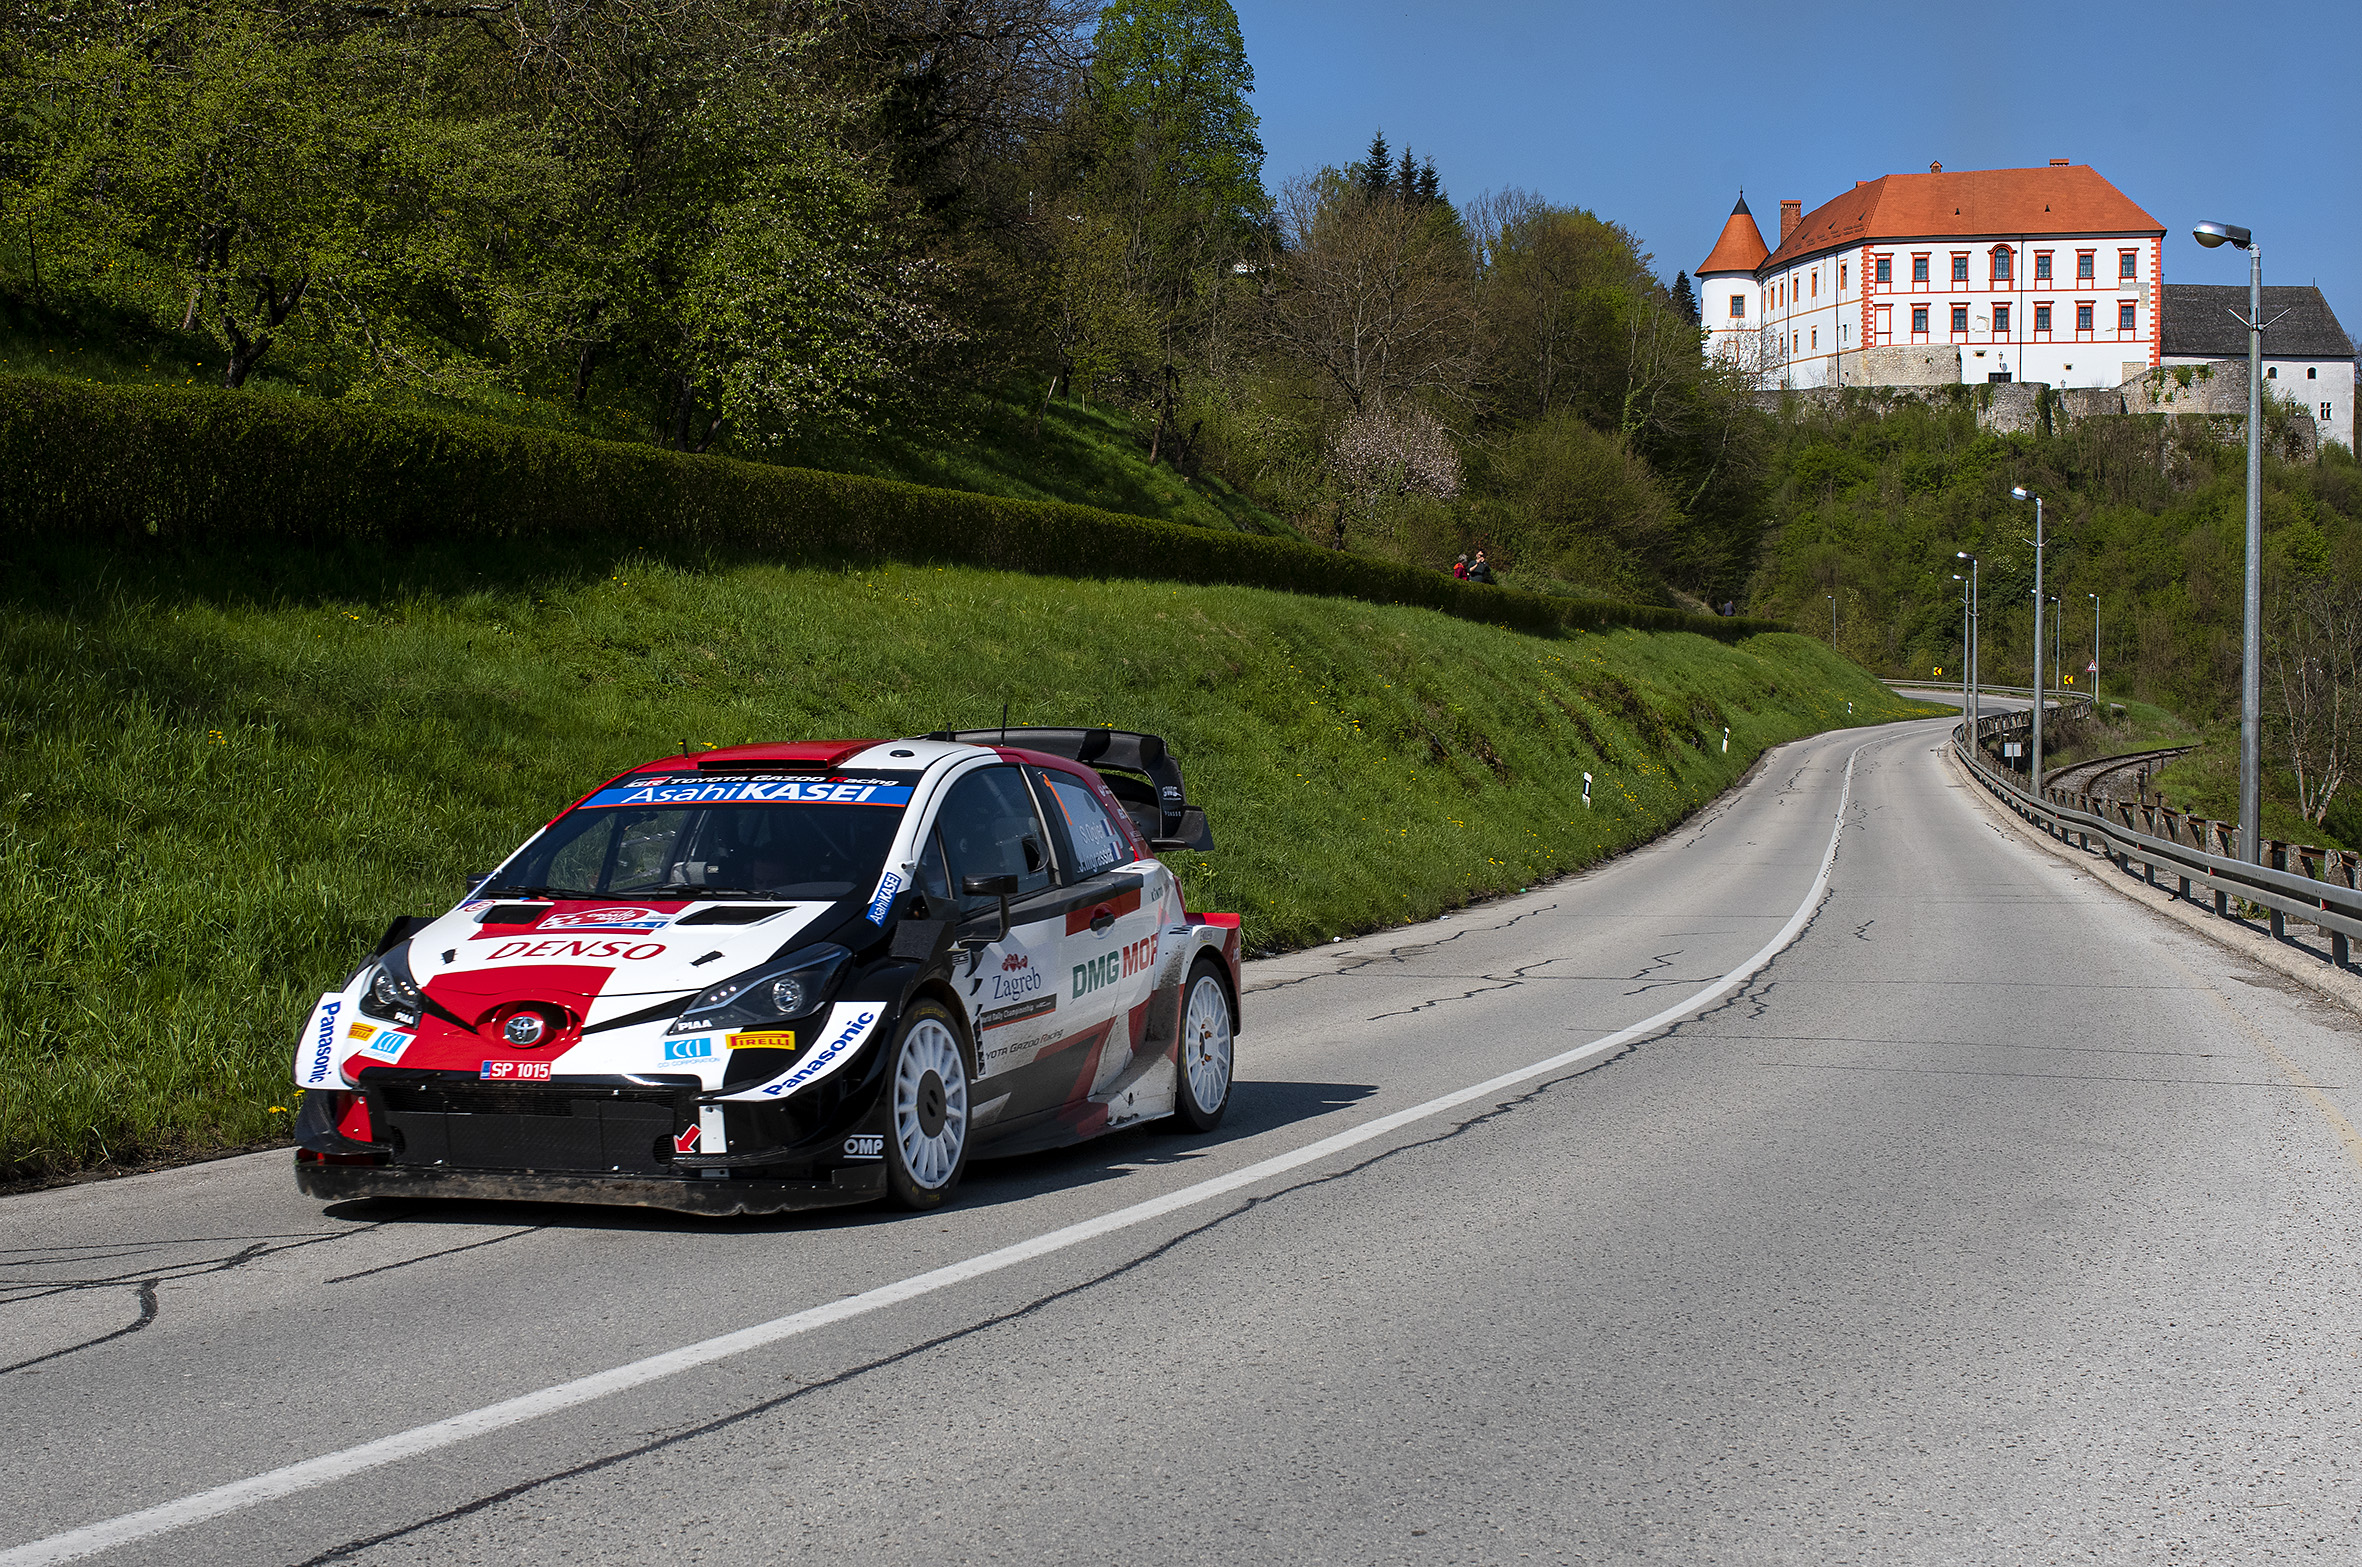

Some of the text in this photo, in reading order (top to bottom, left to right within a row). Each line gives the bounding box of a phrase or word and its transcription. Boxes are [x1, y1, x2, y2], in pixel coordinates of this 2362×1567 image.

[671, 777, 748, 785] TOYOTA
[827, 776, 899, 787] Racing
[620, 783, 877, 803] AsahiKASEI
[870, 873, 900, 925] AsahiKASEI
[485, 940, 667, 960] DENSO
[1072, 932, 1158, 999] DMG MOR
[992, 966, 1041, 1001] Zagreb
[678, 1019, 712, 1031] PIAA
[308, 1001, 341, 1083] Panasonic
[673, 1040, 701, 1057] CCI
[731, 1033, 789, 1046] PIRELLI
[986, 1047, 1008, 1060] YOTA
[1040, 1028, 1064, 1043] Racing
[763, 1012, 874, 1096] Panasonic
[491, 1063, 549, 1078] SP 1015
[843, 1138, 884, 1154] OMP
